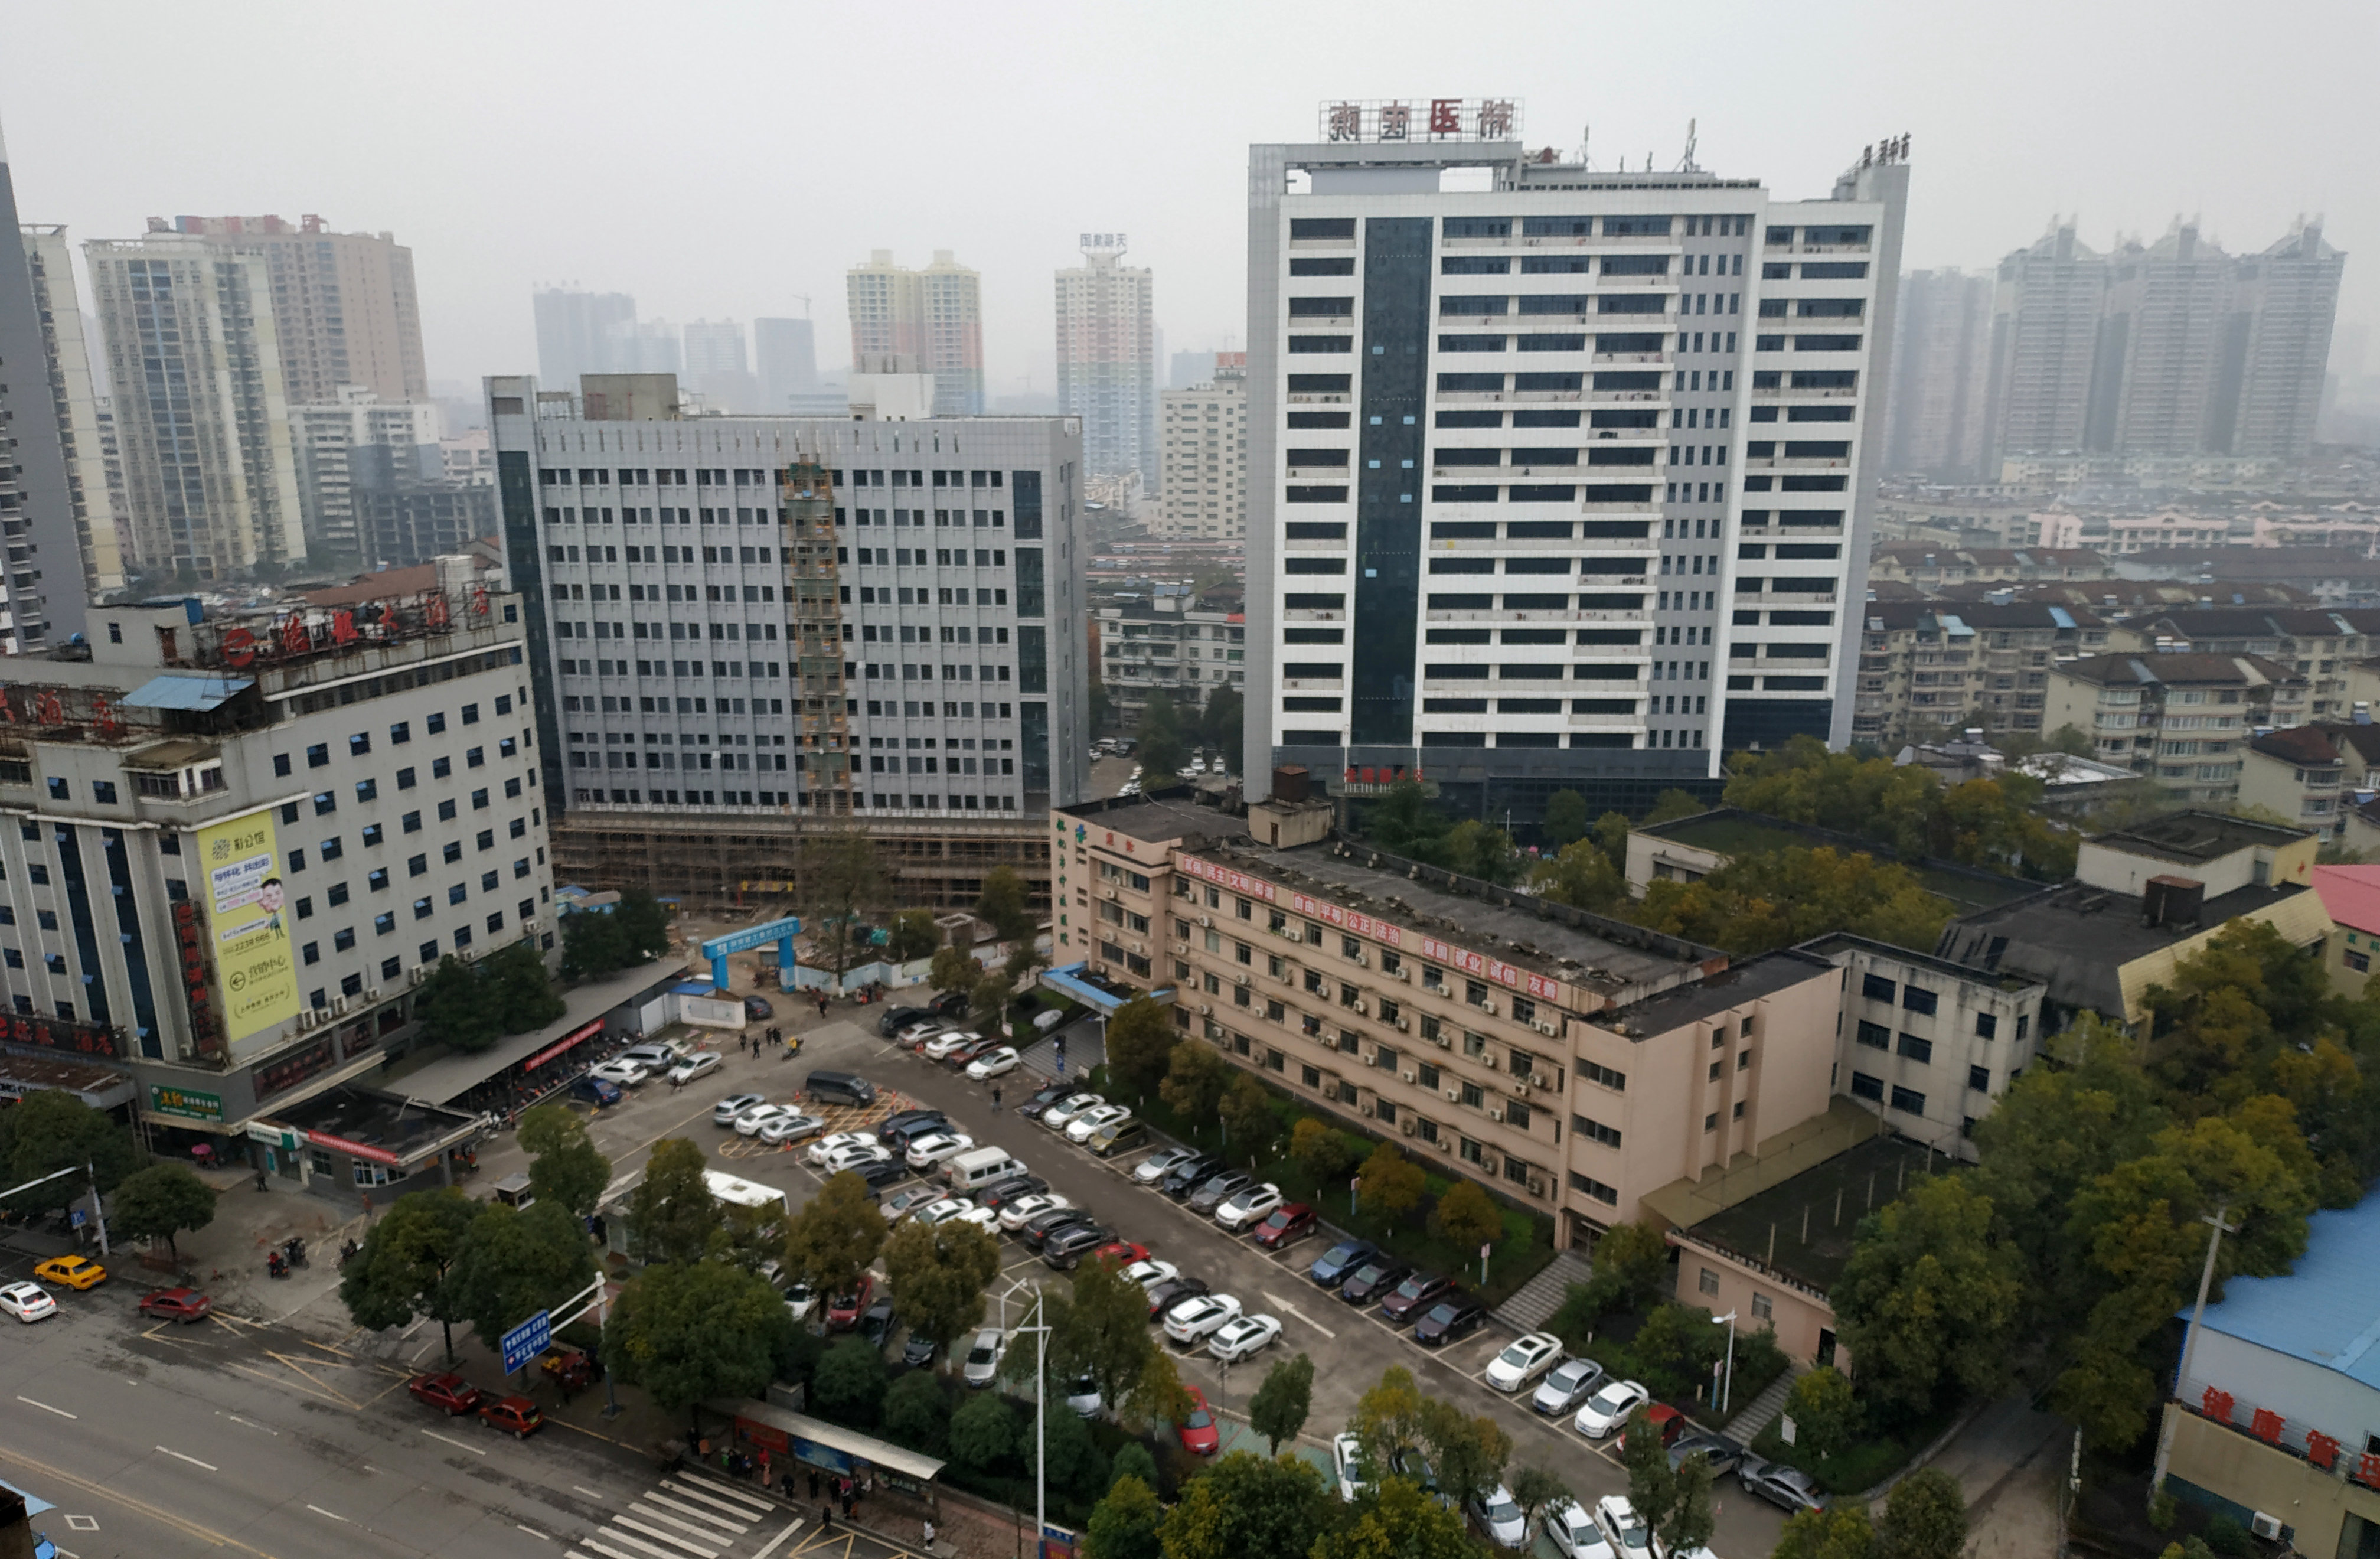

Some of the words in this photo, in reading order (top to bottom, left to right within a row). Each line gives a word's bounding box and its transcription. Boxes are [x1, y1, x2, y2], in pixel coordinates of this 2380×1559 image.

[1185, 856, 1202, 875] 富强
[1207, 865, 1226, 883] 民主
[1230, 872, 1249, 891] 文明
[1254, 880, 1274, 901] 和谐
[1294, 895, 1315, 915] 自由
[1321, 904, 1343, 925] 平等
[1348, 914, 1370, 934] 公正
[1376, 923, 1400, 944] 法治
[1423, 940, 1448, 961] 爱国
[1455, 950, 1481, 973] 敬业
[1490, 960, 1516, 986] 诚信
[1529, 975, 1556, 1000] 友善
